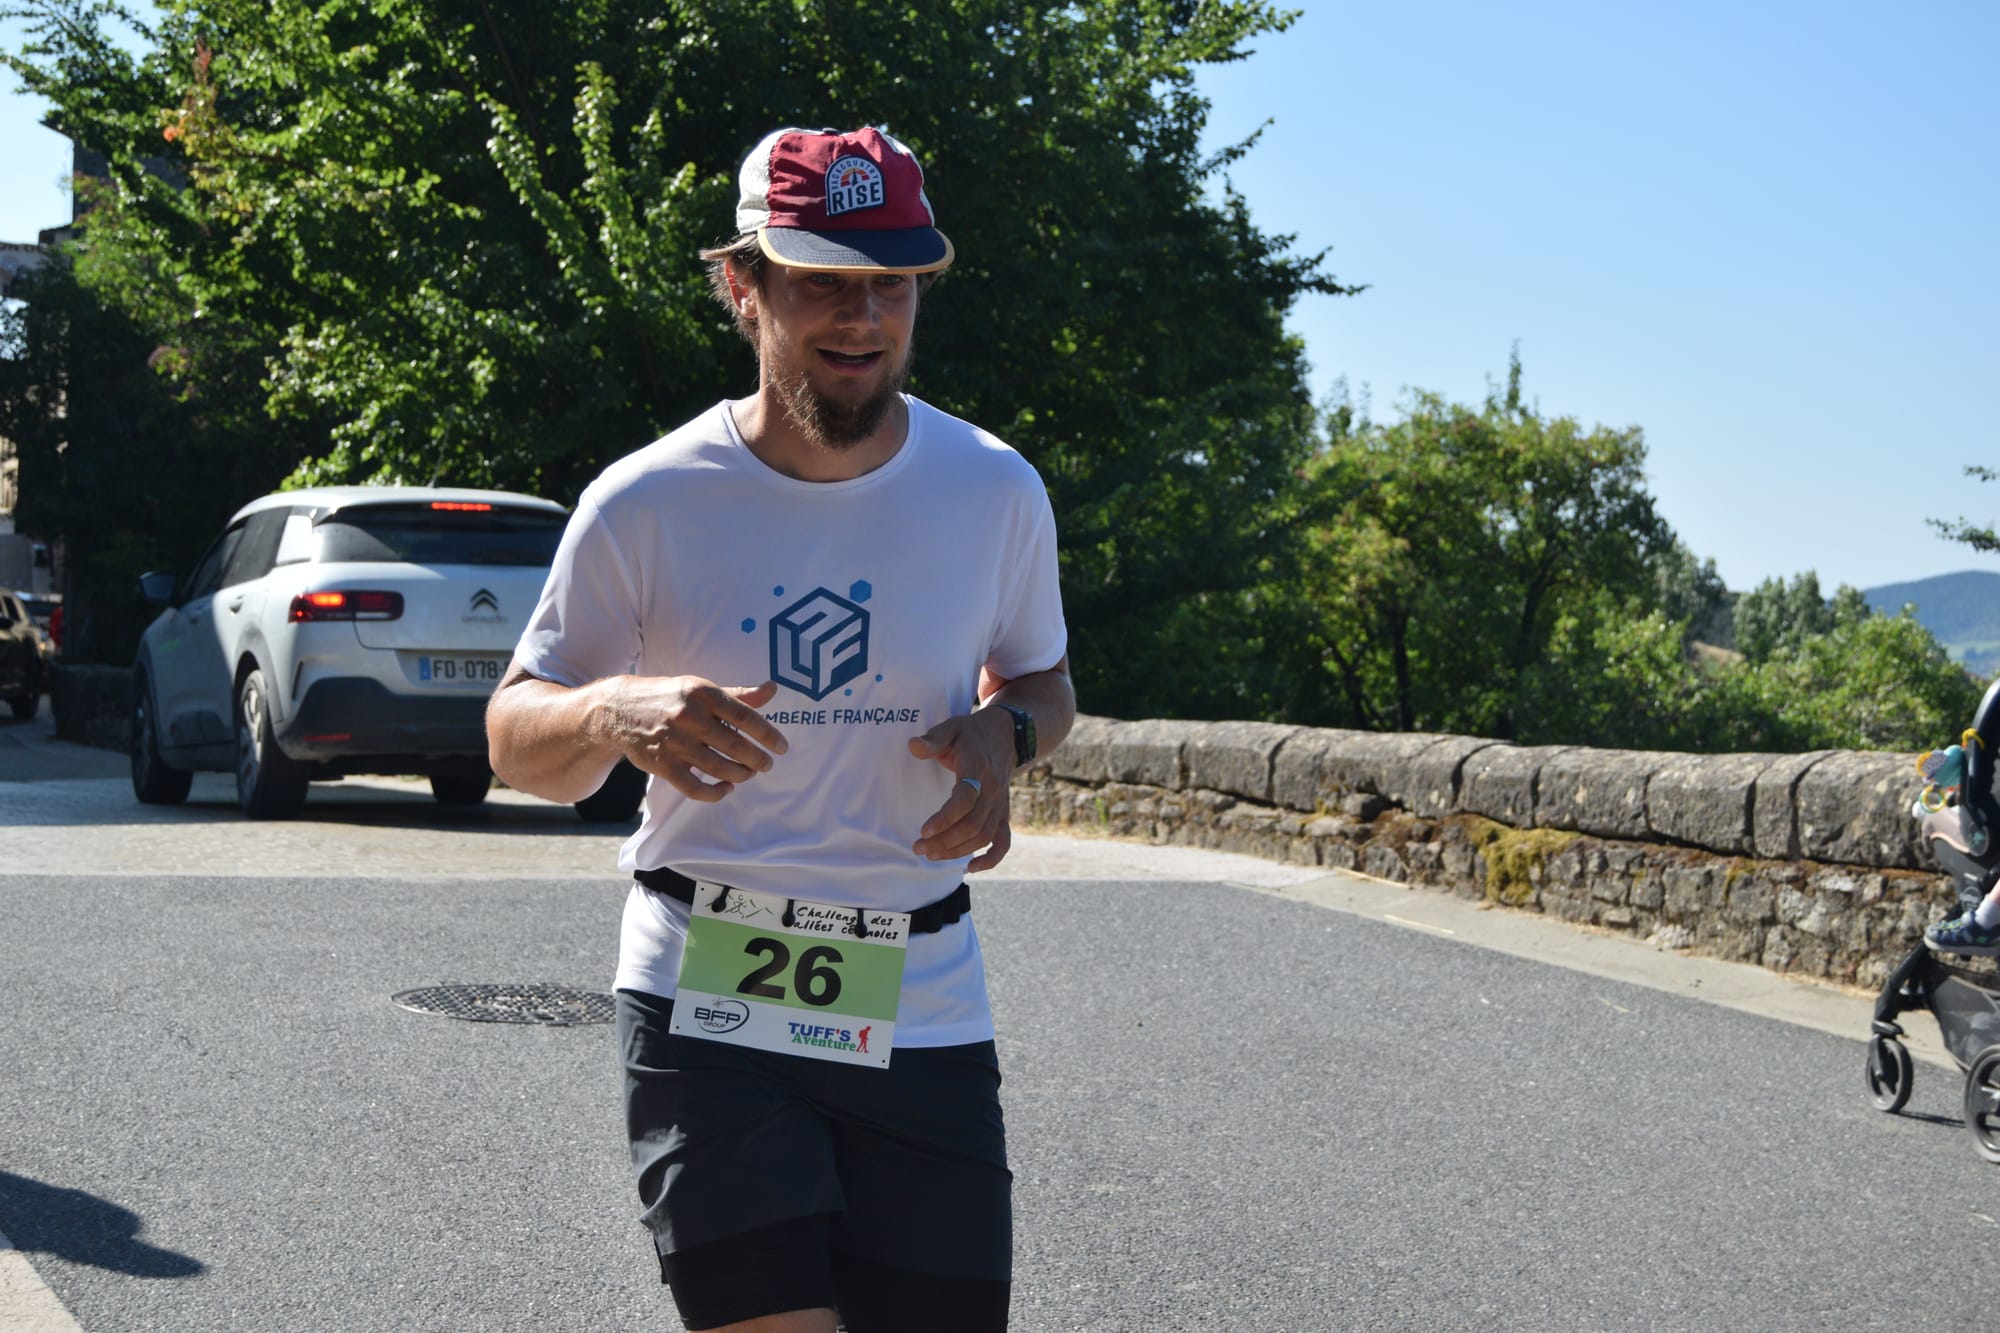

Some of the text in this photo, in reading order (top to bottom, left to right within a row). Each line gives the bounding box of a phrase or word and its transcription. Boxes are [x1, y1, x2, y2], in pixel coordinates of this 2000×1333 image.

[832, 181, 881, 212] RISE
[765, 707, 920, 726] MBERIE FRANÇAISE
[793, 920, 834, 933] allées
[796, 906, 893, 927] Challeng des
[735, 936, 844, 1007] 26
[694, 1007, 741, 1024] BFP
[703, 1021, 726, 1029] GROUP
[788, 1022, 851, 1042] TUFF'S
[791, 1032, 857, 1052] Aventure
